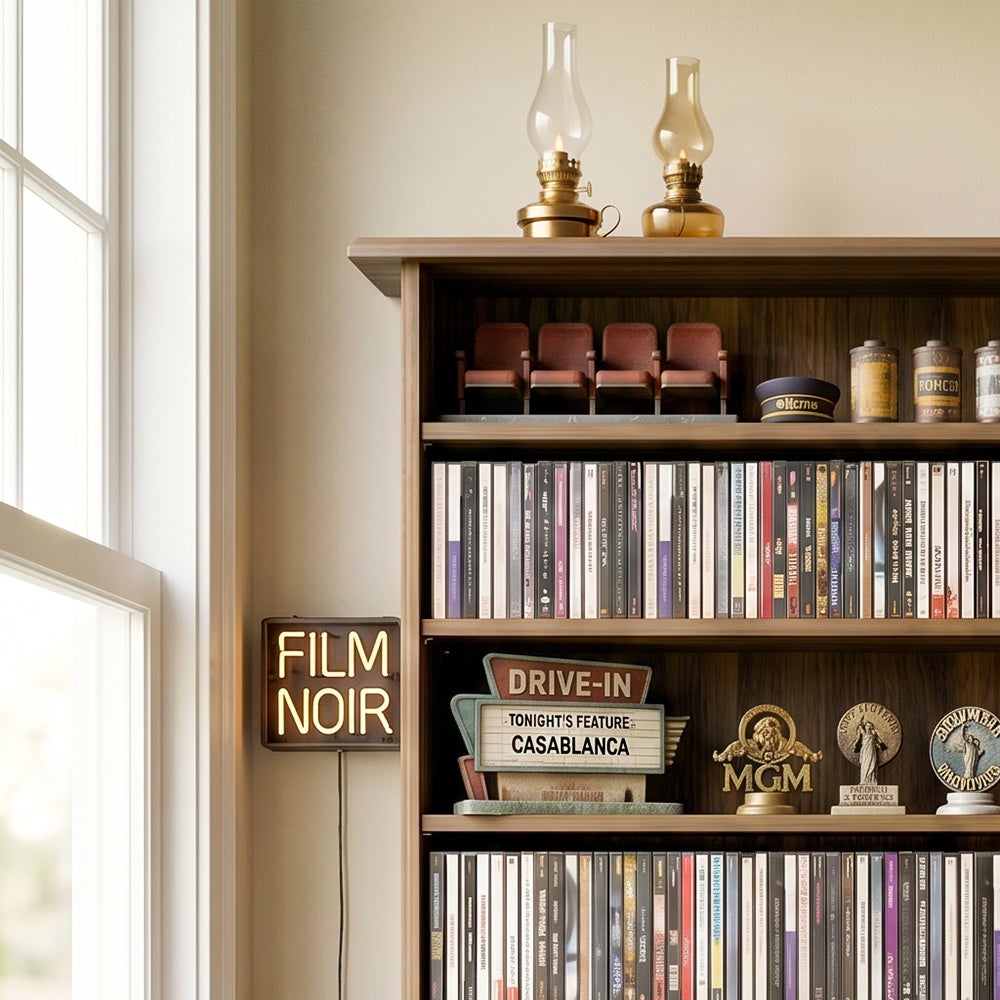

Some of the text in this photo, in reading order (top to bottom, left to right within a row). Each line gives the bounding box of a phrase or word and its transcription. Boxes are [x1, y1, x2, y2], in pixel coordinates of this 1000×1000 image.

[277, 630, 389, 679] FILM
[508, 668, 631, 698] DRIVE-IN
[277, 687, 394, 736] NOIR
[508, 713, 573, 729] TONIGHT'S
[511, 735, 630, 756] CASABLANCA
[722, 763, 814, 792] MGM
